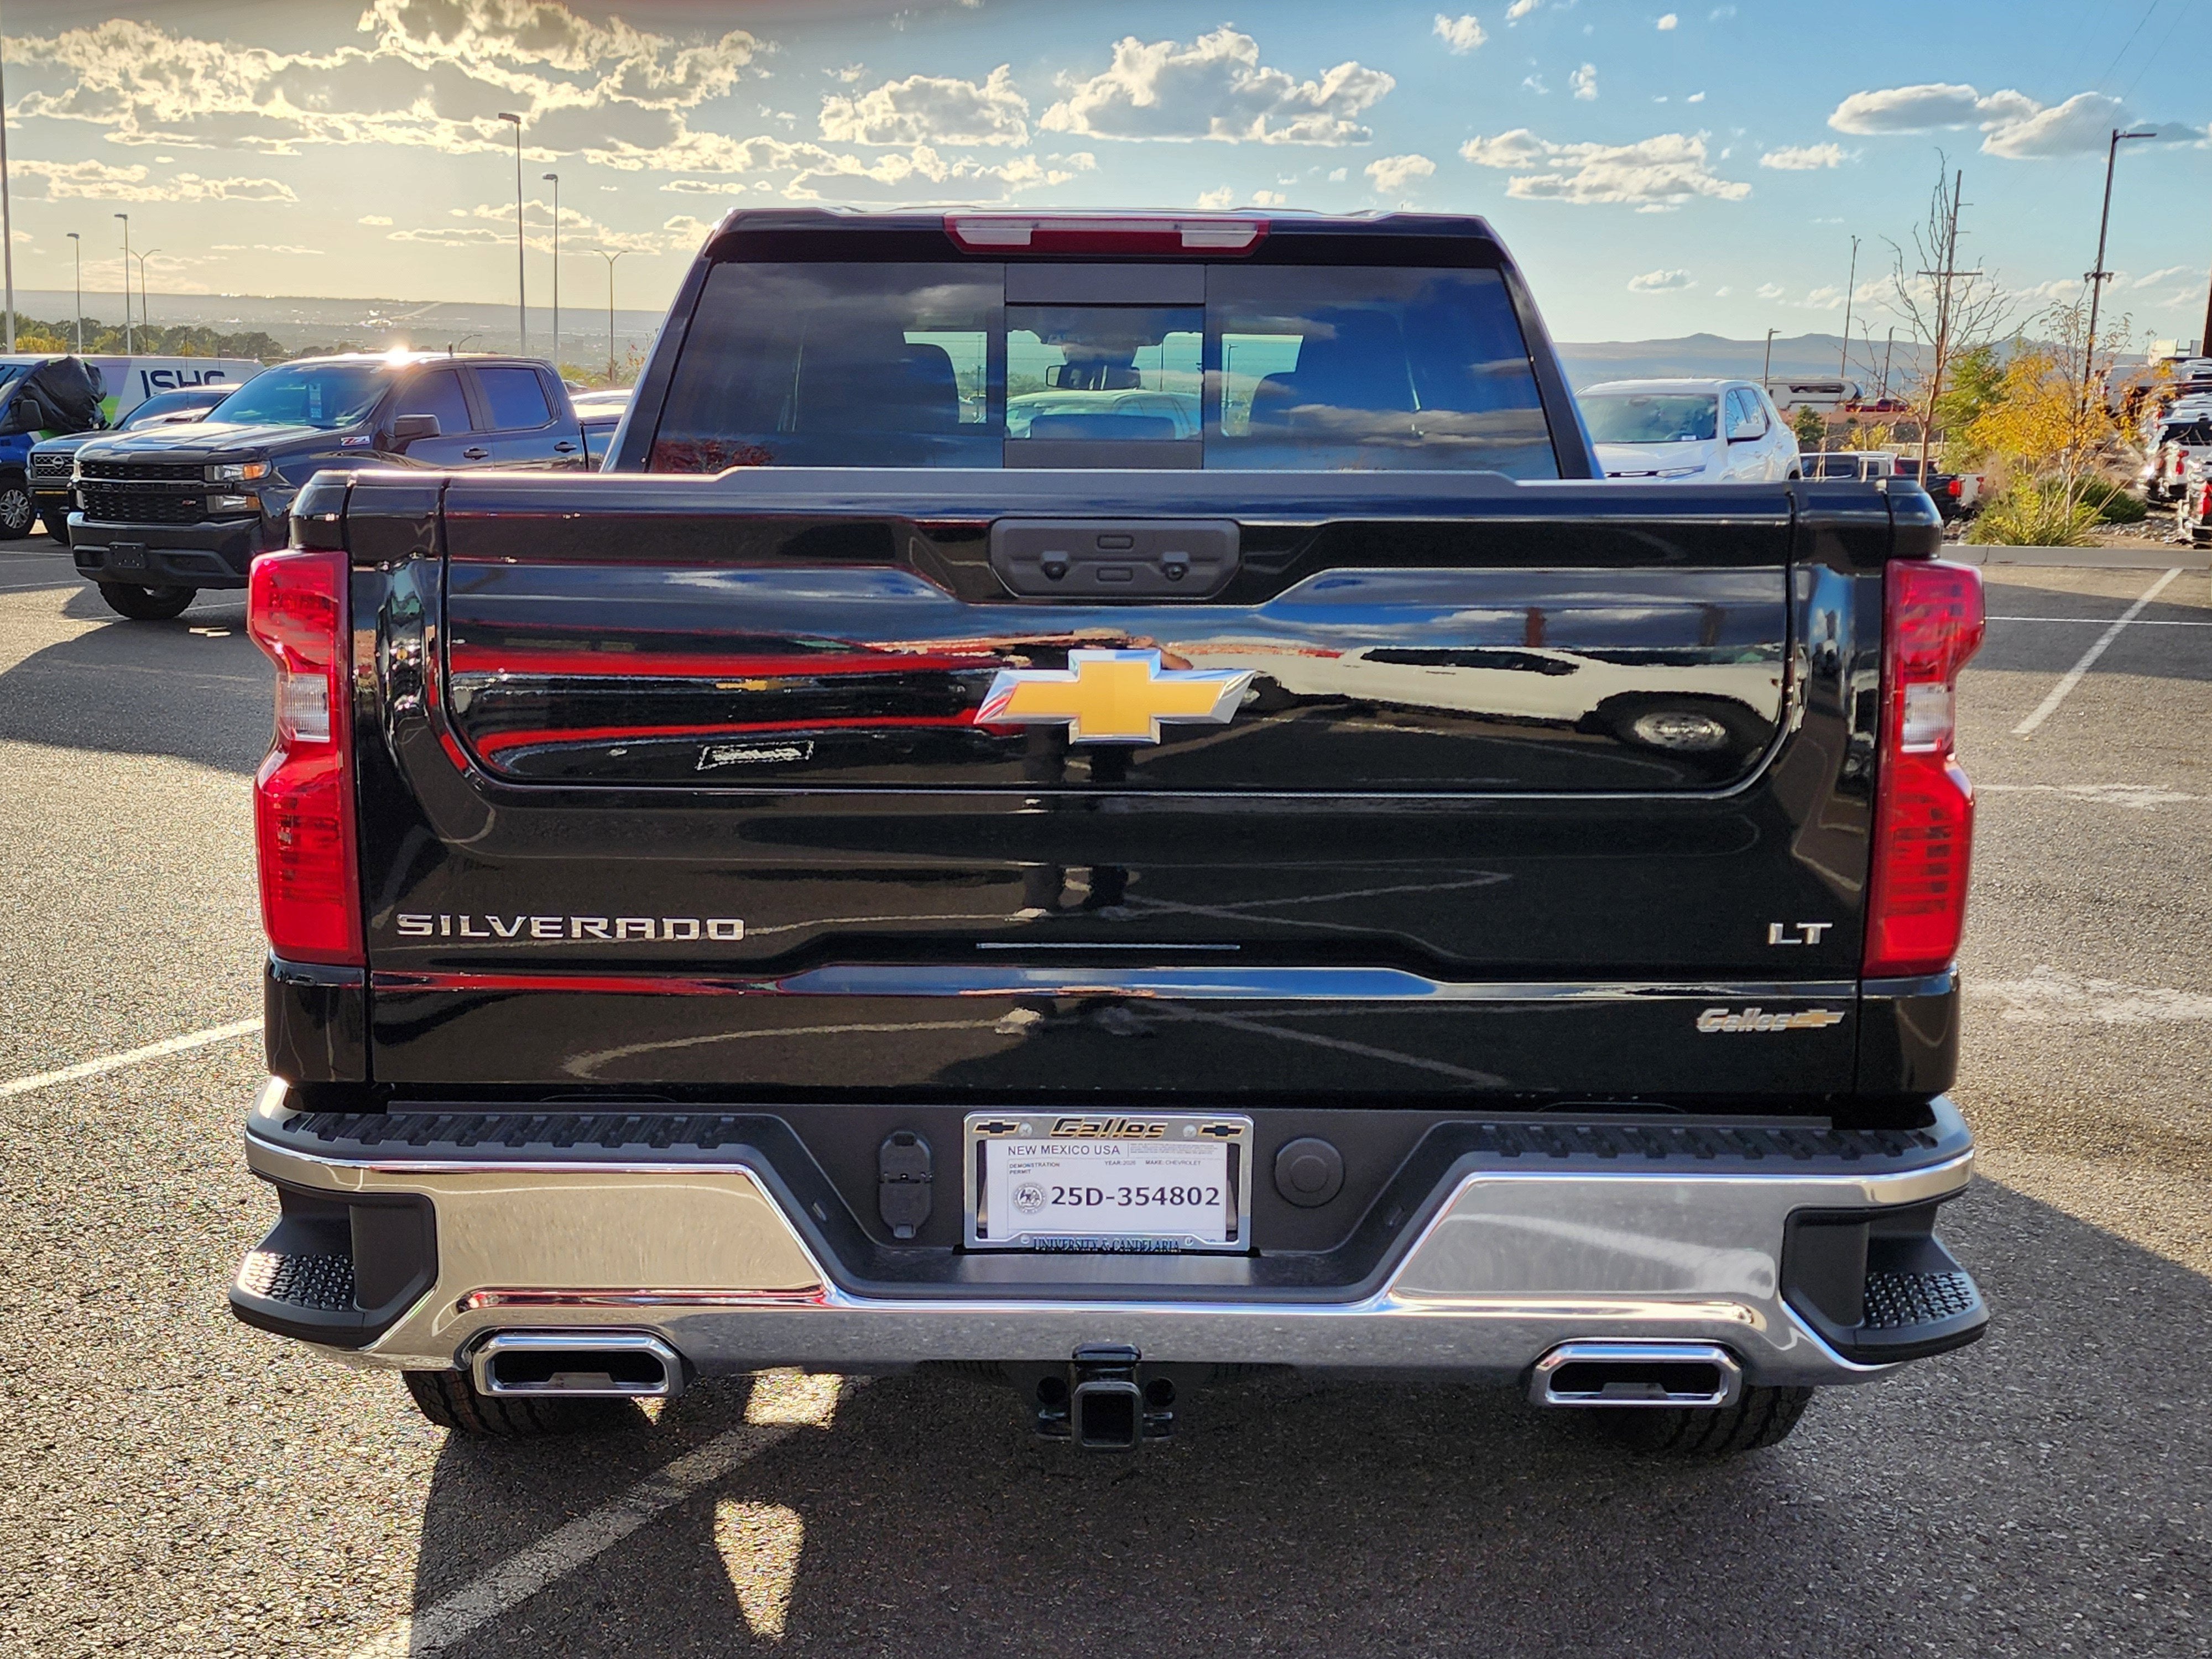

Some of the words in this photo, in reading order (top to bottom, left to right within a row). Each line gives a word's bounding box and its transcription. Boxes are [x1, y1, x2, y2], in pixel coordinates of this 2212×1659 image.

[397, 914, 745, 941] SILVERADO
[1768, 922, 1833, 945] LT
[1050, 1117, 1168, 1139] Galles
[1008, 1145, 1037, 1156] NEW
[1041, 1145, 1090, 1155] MEXICO
[1094, 1145, 1120, 1155] USA
[1051, 1186, 1220, 1206] 25D-354802
